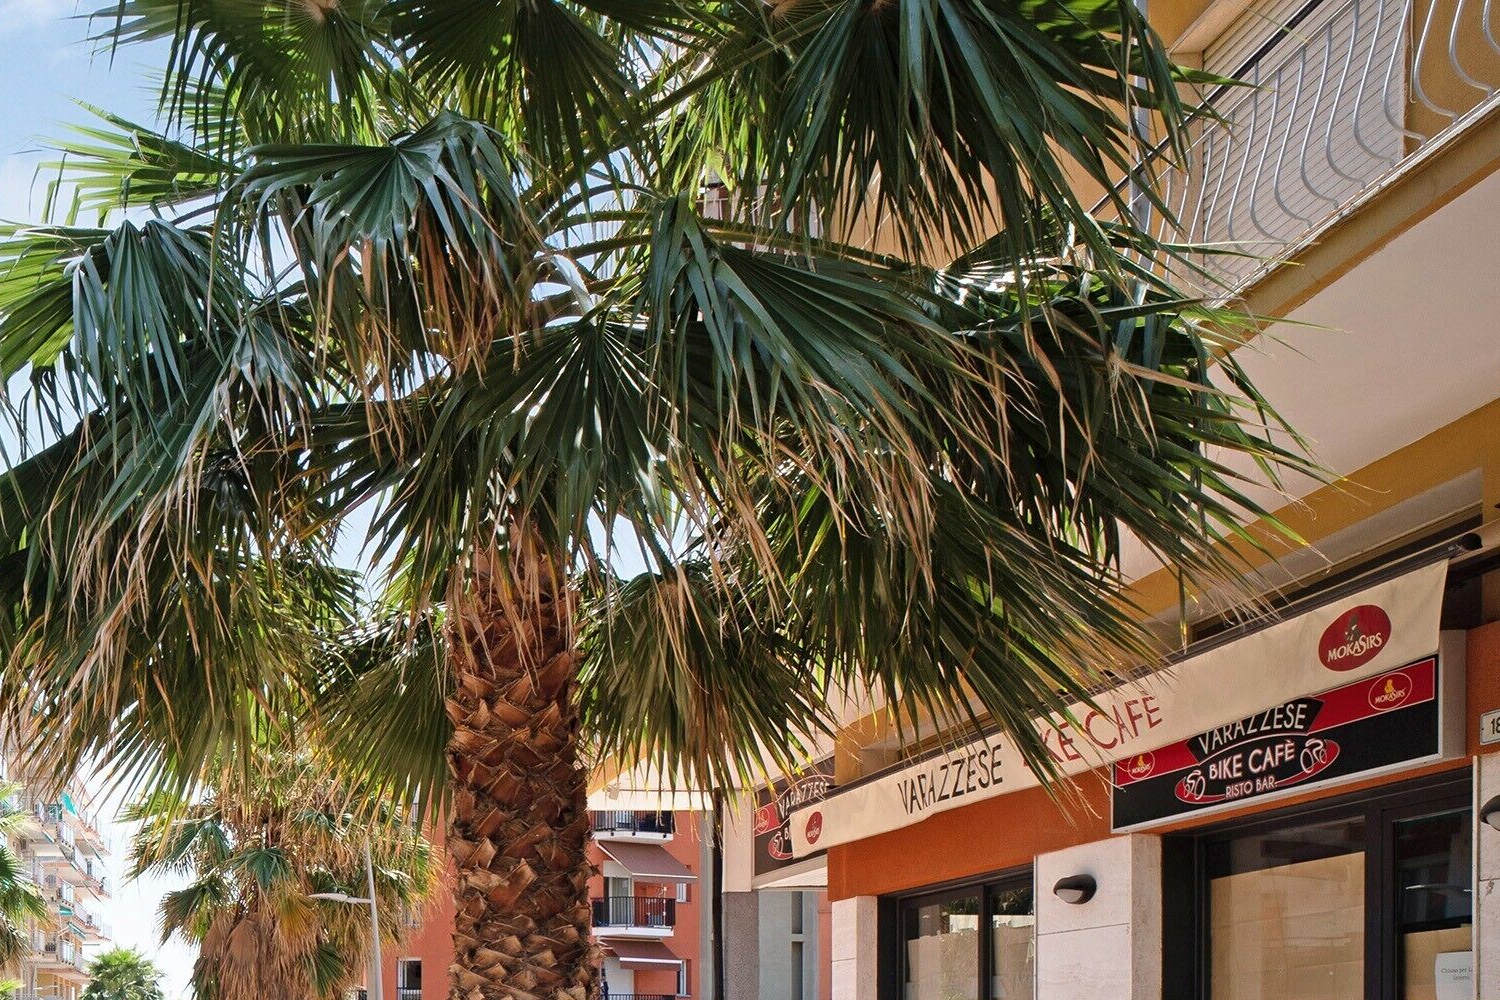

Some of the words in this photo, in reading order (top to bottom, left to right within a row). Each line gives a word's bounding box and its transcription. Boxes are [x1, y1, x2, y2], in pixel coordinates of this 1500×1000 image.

[1198, 703, 1308, 755] VARAZZESE
[897, 744, 1003, 815] VARAZZESE
[1209, 753, 1243, 780] BIKE
[1248, 739, 1296, 774] CAFÈ
[1225, 781, 1253, 799] RISTO
[1255, 775, 1276, 793] BAR
